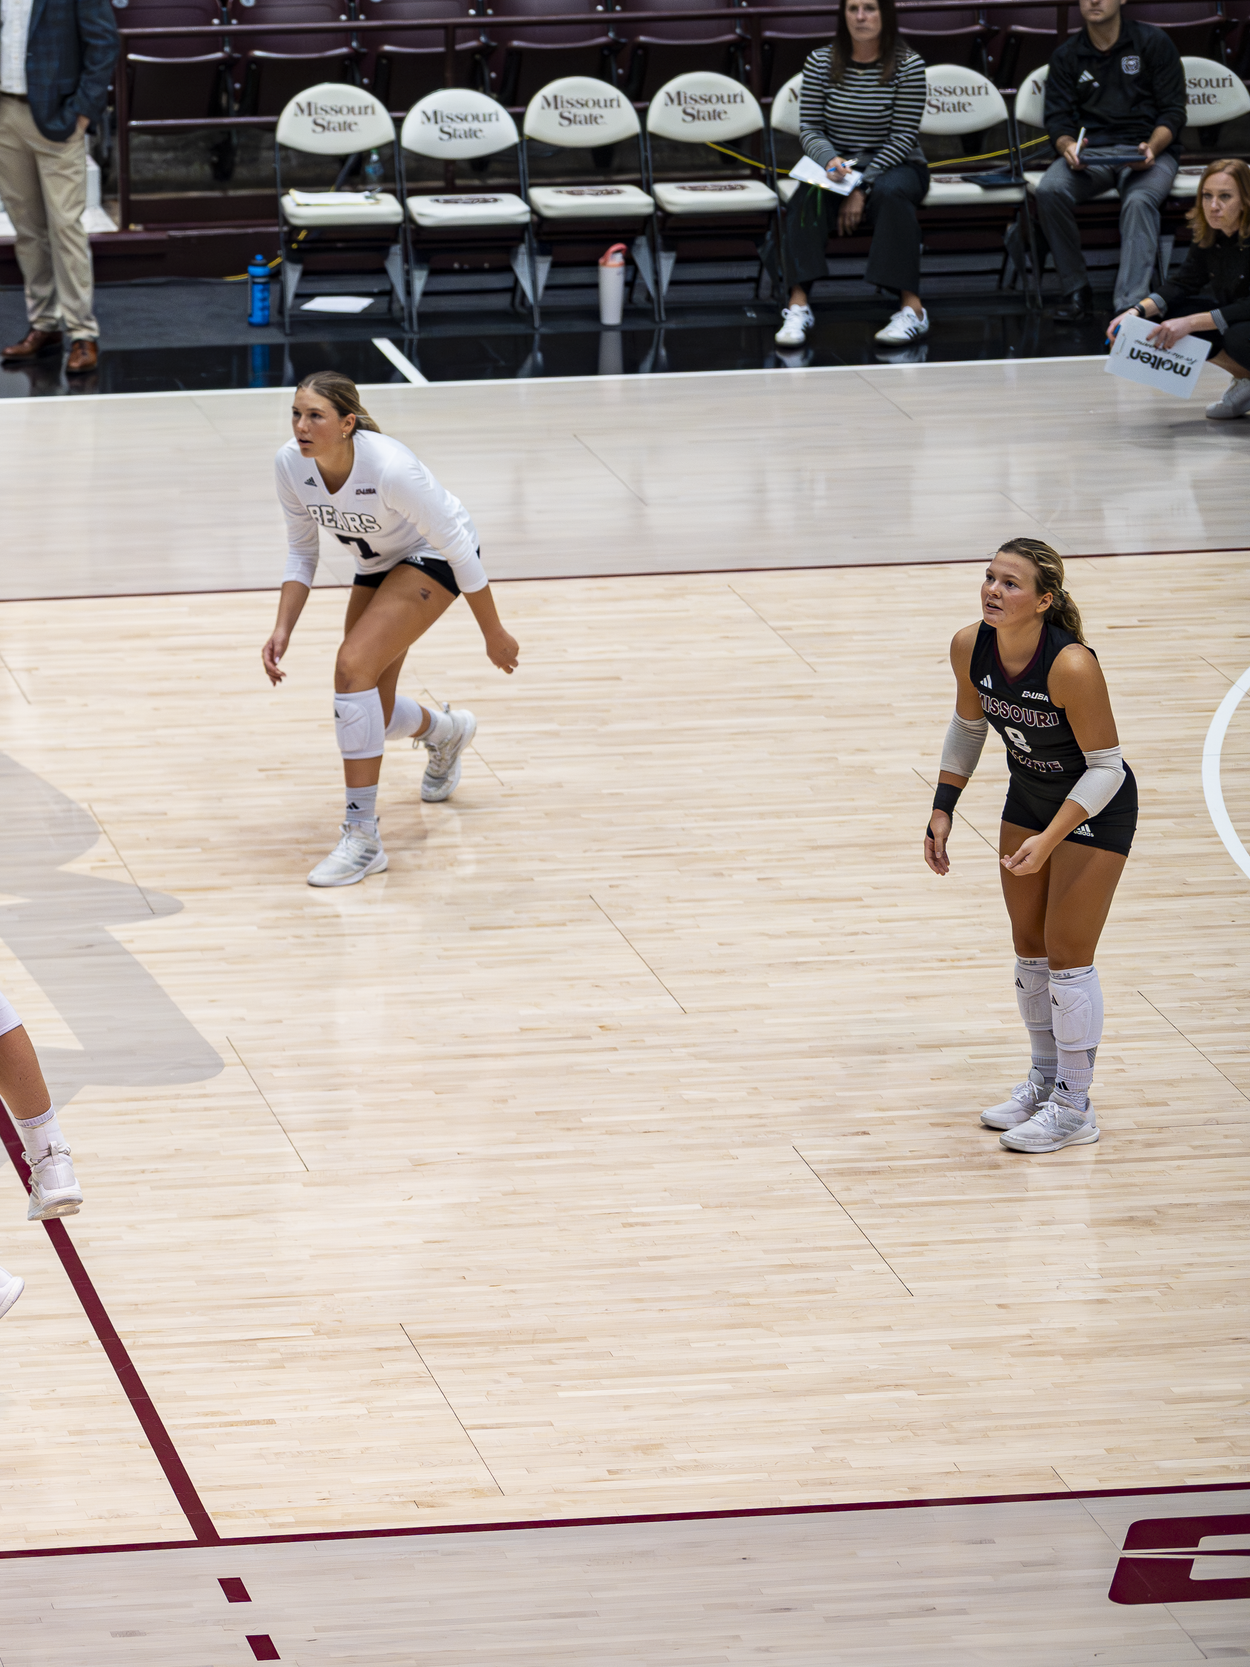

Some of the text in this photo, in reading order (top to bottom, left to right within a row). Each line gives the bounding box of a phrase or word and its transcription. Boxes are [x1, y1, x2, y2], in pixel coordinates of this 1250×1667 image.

[1186, 74, 1234, 89] souri
[926, 82, 989, 98] issouri
[541, 94, 621, 110] Missouri
[664, 90, 744, 107] Missouri
[1186, 92, 1217, 105] ate
[293, 101, 376, 117] Missouri
[682, 106, 728, 124] State
[926, 99, 972, 115] State
[421, 109, 500, 125] Missouri
[559, 111, 604, 127] State
[311, 118, 358, 134] State
[438, 126, 483, 142] State
[1129, 347, 1191, 377] molten
[306, 504, 381, 533] BEARS
[335, 533, 381, 560] 7
